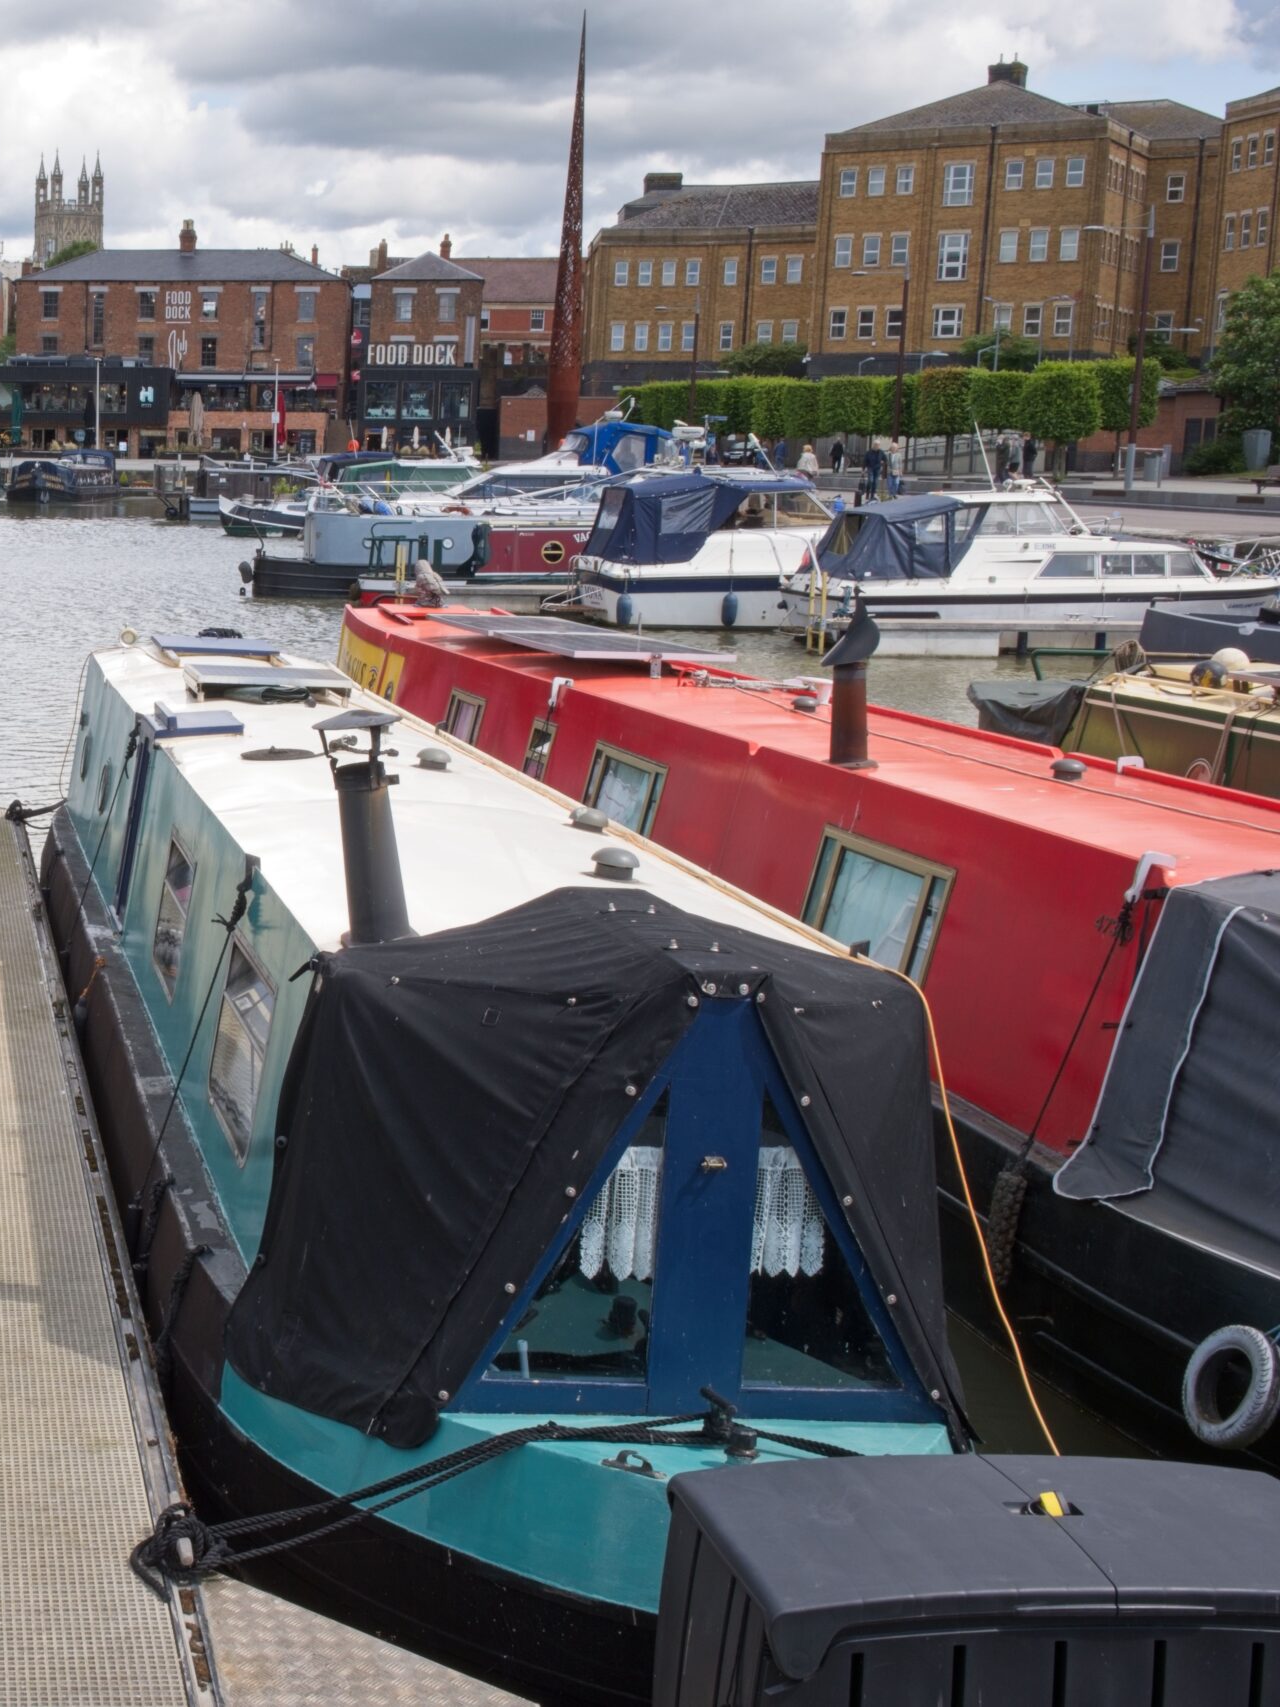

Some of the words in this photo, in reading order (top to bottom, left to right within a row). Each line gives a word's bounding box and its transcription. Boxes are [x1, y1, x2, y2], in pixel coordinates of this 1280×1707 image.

[165, 291, 191, 305] FOOD
[165, 306, 191, 319] DOCK
[367, 344, 408, 365] FOOD
[413, 344, 456, 365] DOCK
